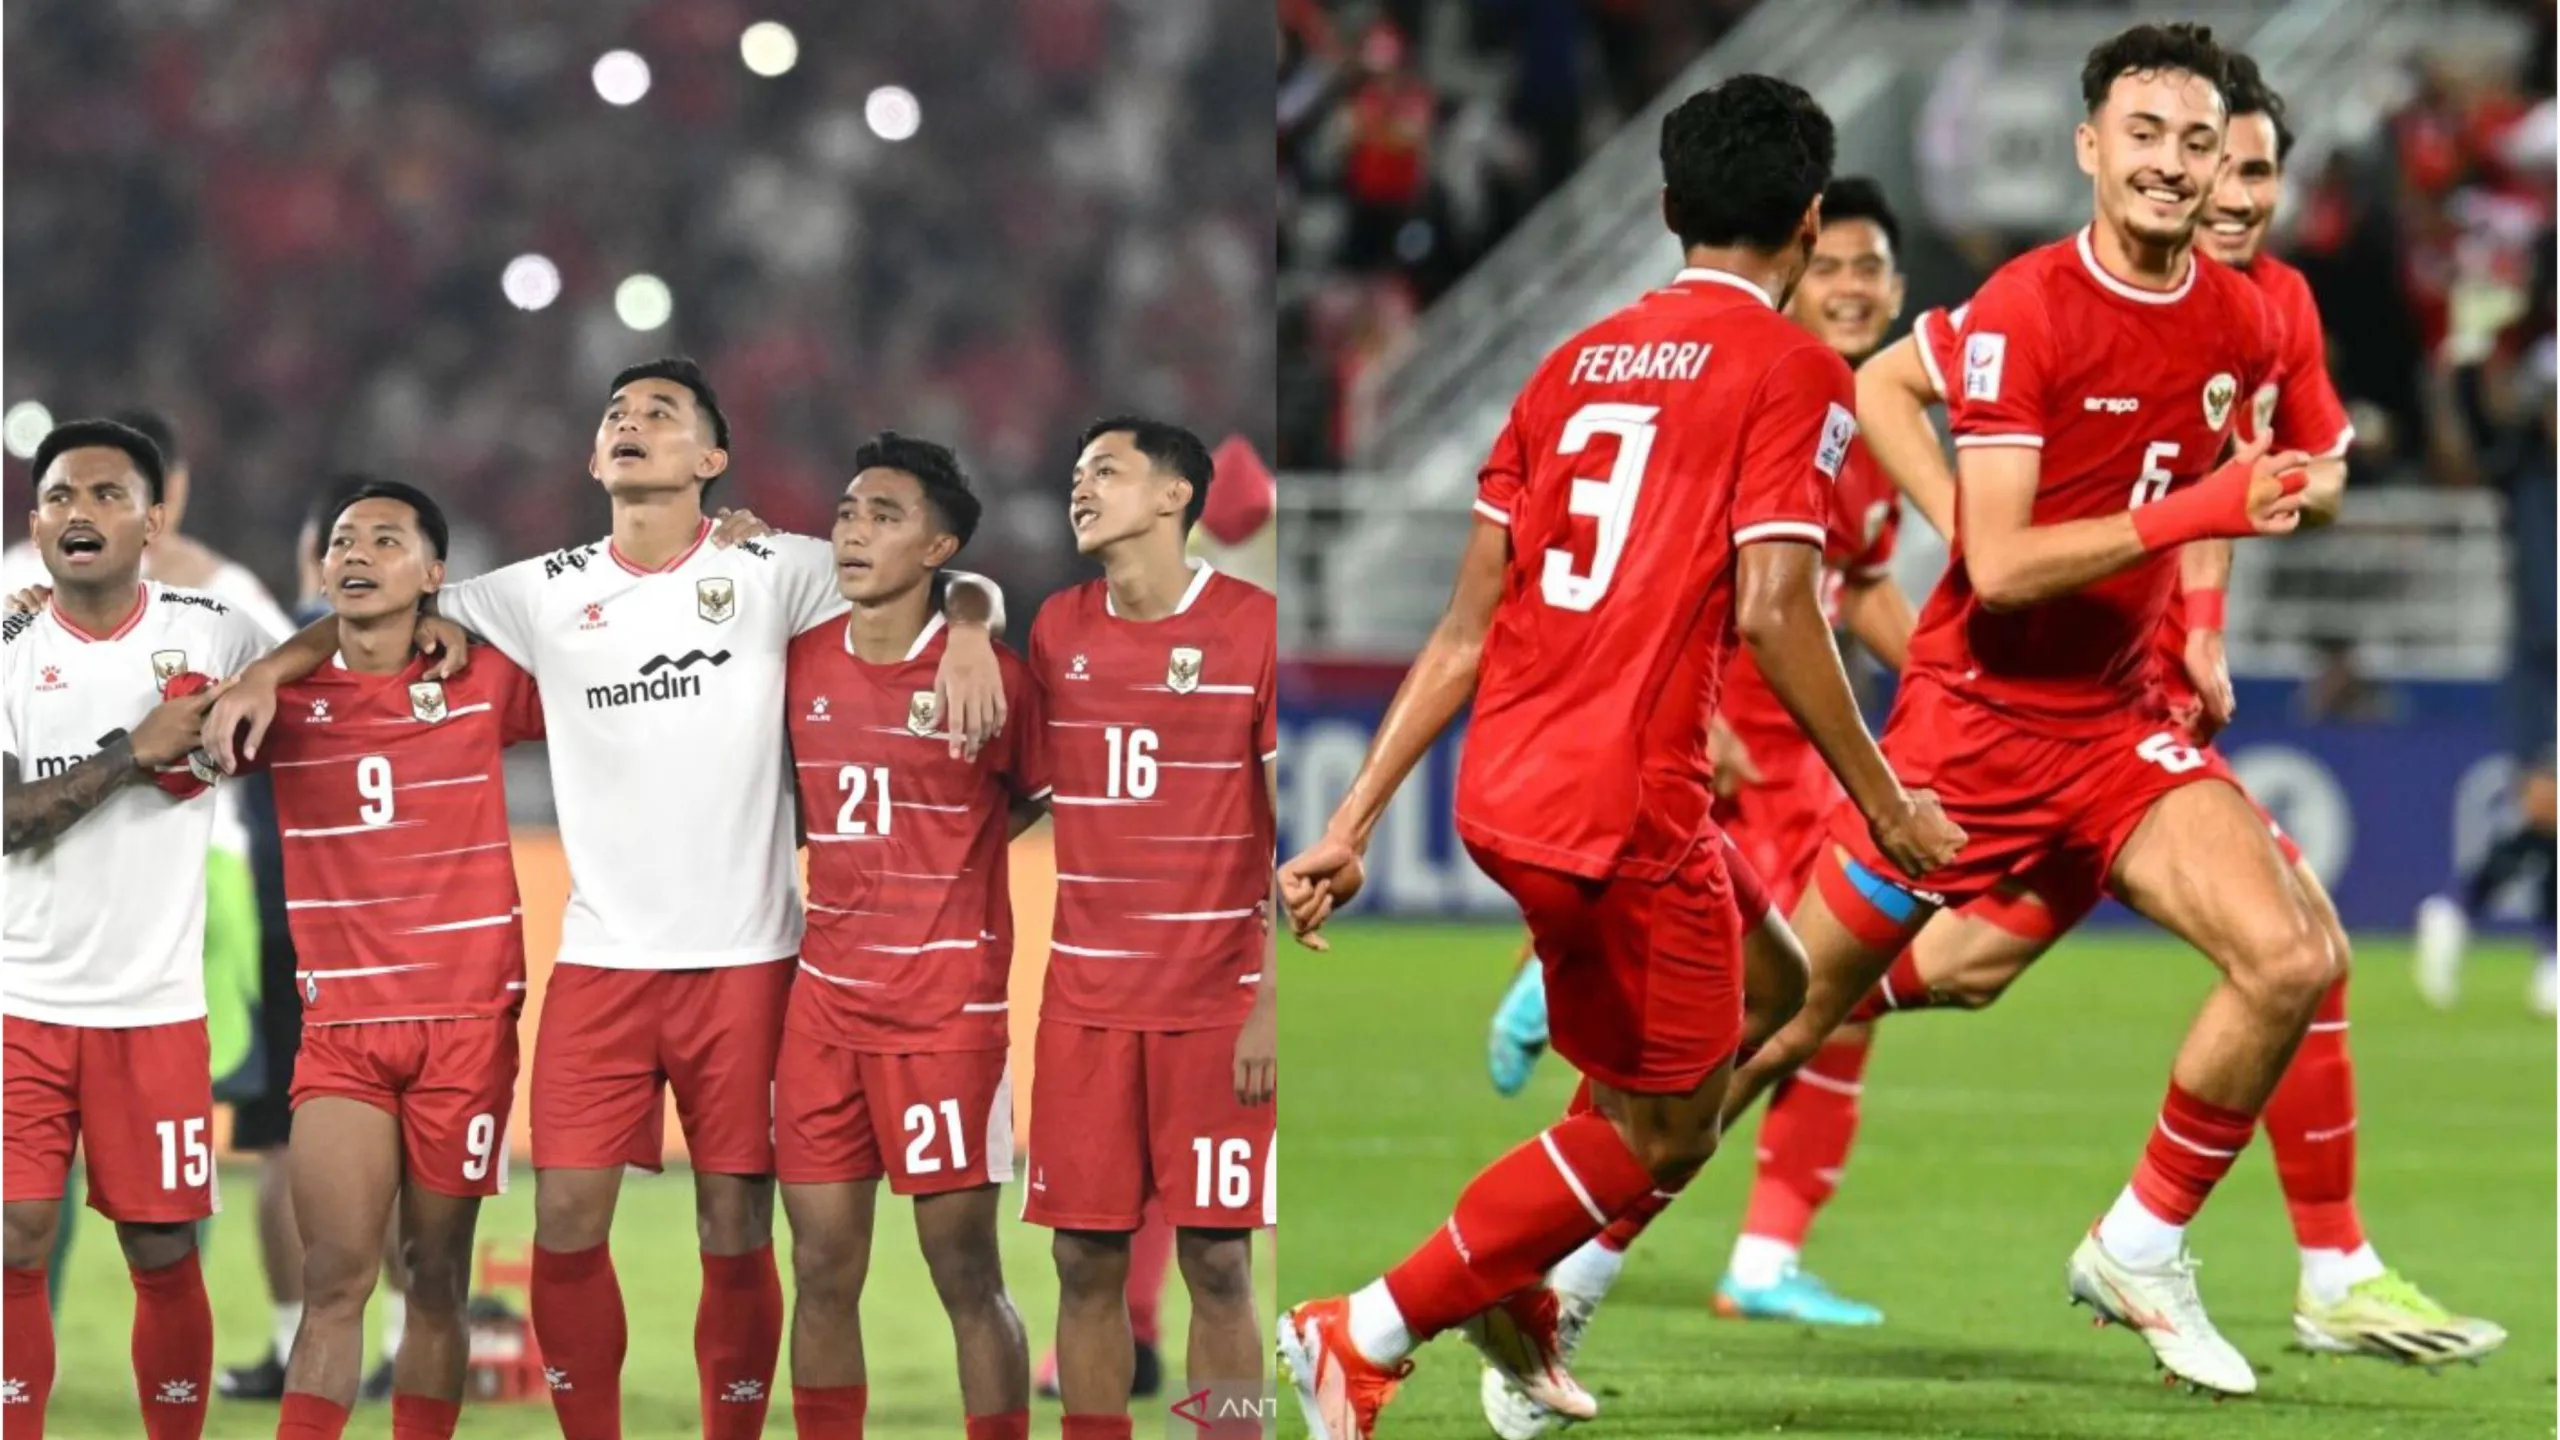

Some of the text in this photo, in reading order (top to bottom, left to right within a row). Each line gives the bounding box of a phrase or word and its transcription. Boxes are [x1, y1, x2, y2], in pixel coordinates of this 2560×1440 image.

[1569, 342, 1713, 386] FERARRI
[1541, 402, 1662, 613] 3
[2128, 440, 2181, 512] 6
[586, 671, 701, 709] mandiri
[357, 755, 395, 825] 9
[1105, 726, 1159, 799] 16
[837, 765, 891, 835] 21
[156, 1117, 209, 1190] 15
[462, 1113, 495, 1181] 9
[904, 1098, 967, 1174] 21
[1192, 1137, 1252, 1208] 16
